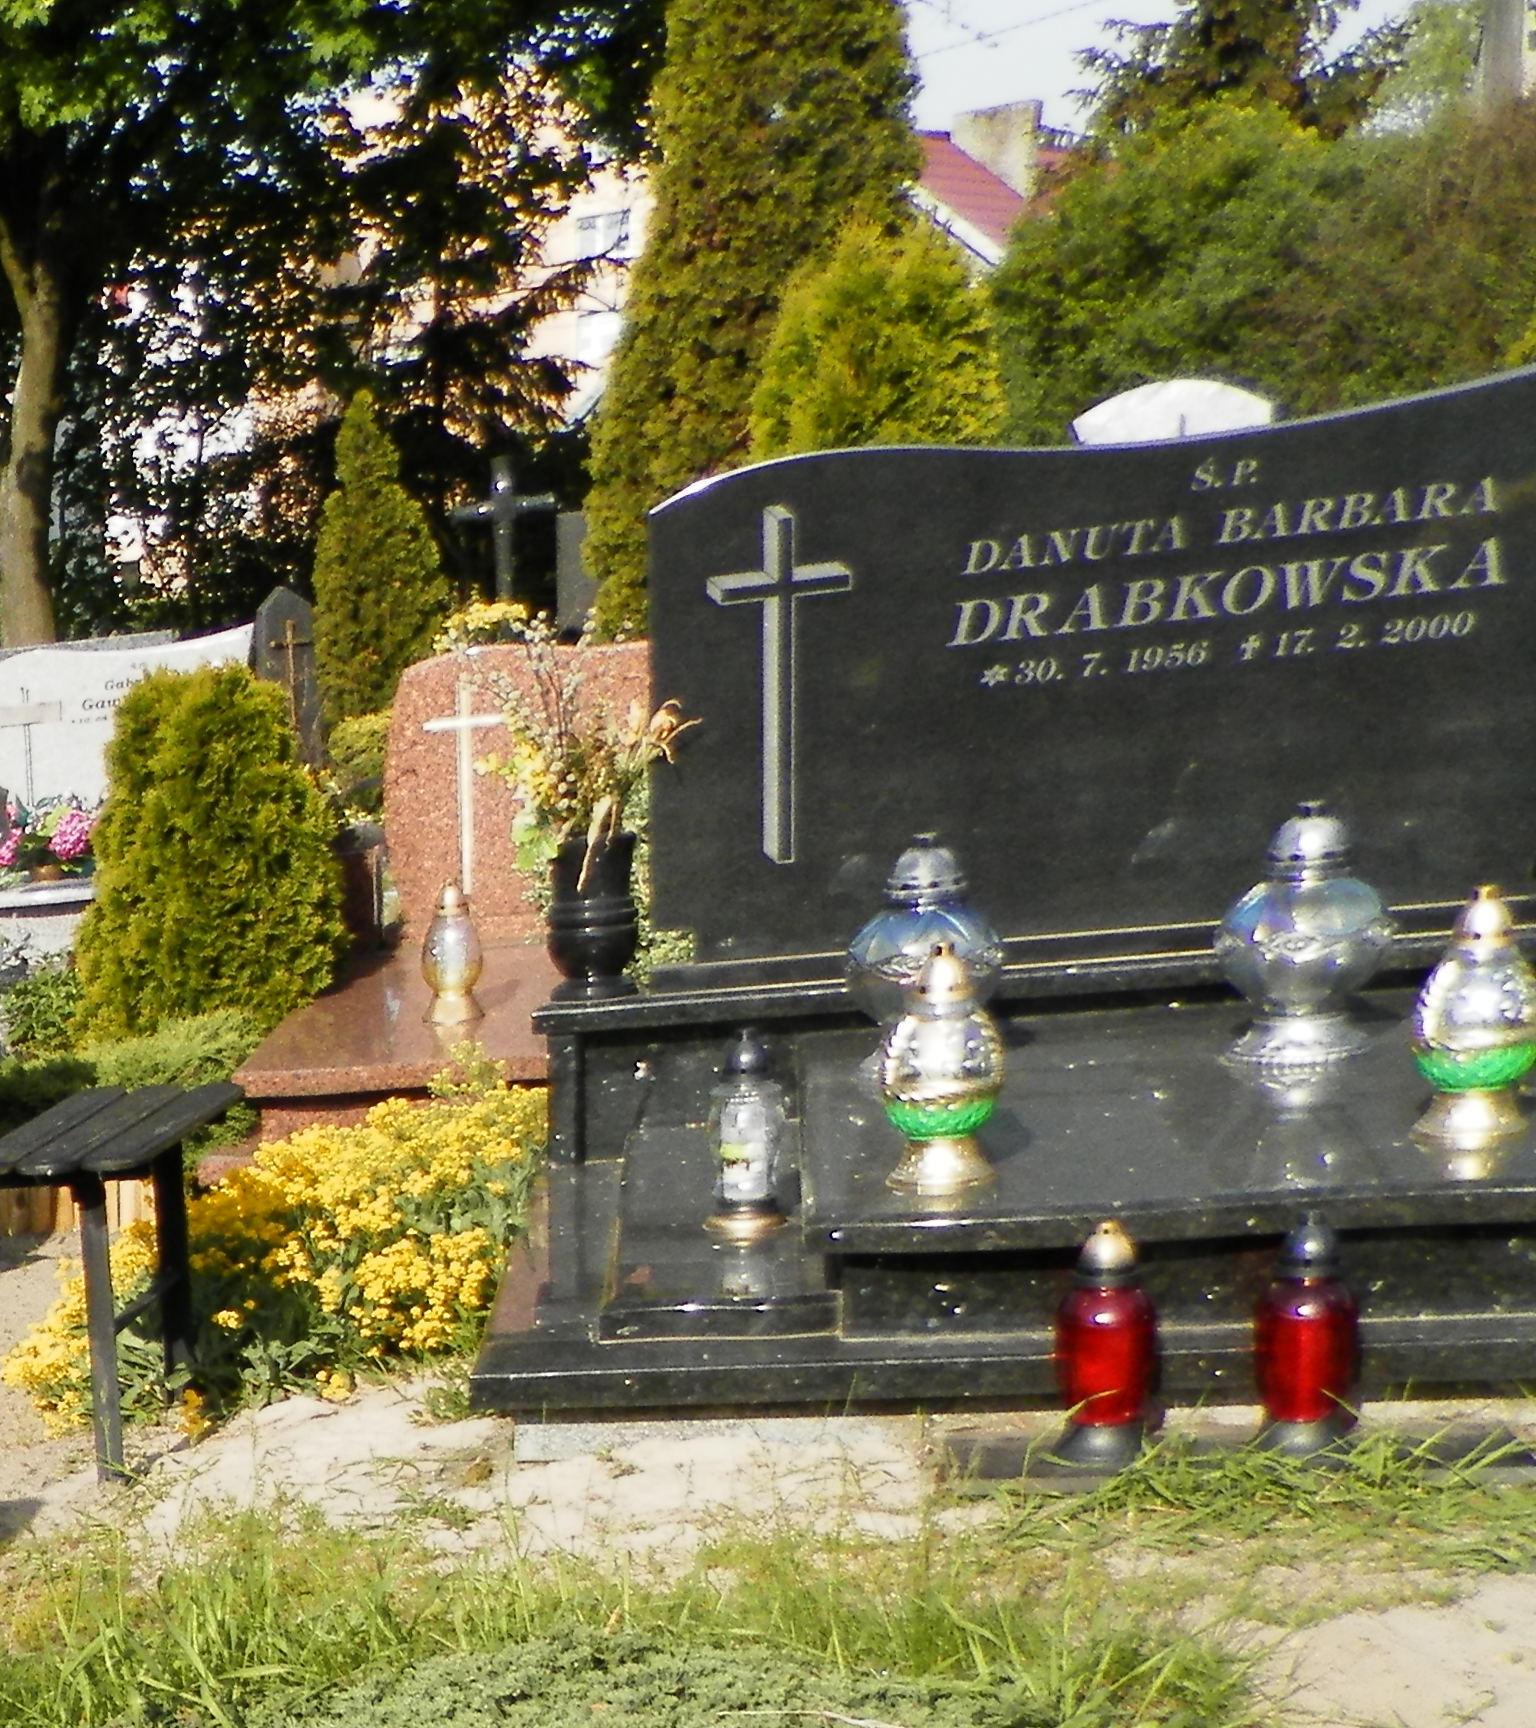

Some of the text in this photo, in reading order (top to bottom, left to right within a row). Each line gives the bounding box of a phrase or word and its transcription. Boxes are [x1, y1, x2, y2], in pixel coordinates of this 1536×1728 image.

[961, 476, 1500, 575] DANUTA BARBARA
[946, 537, 1508, 646] DRABKOWSKA
[1128, 641, 1208, 673] 1956
[1381, 610, 1476, 644] 2000
